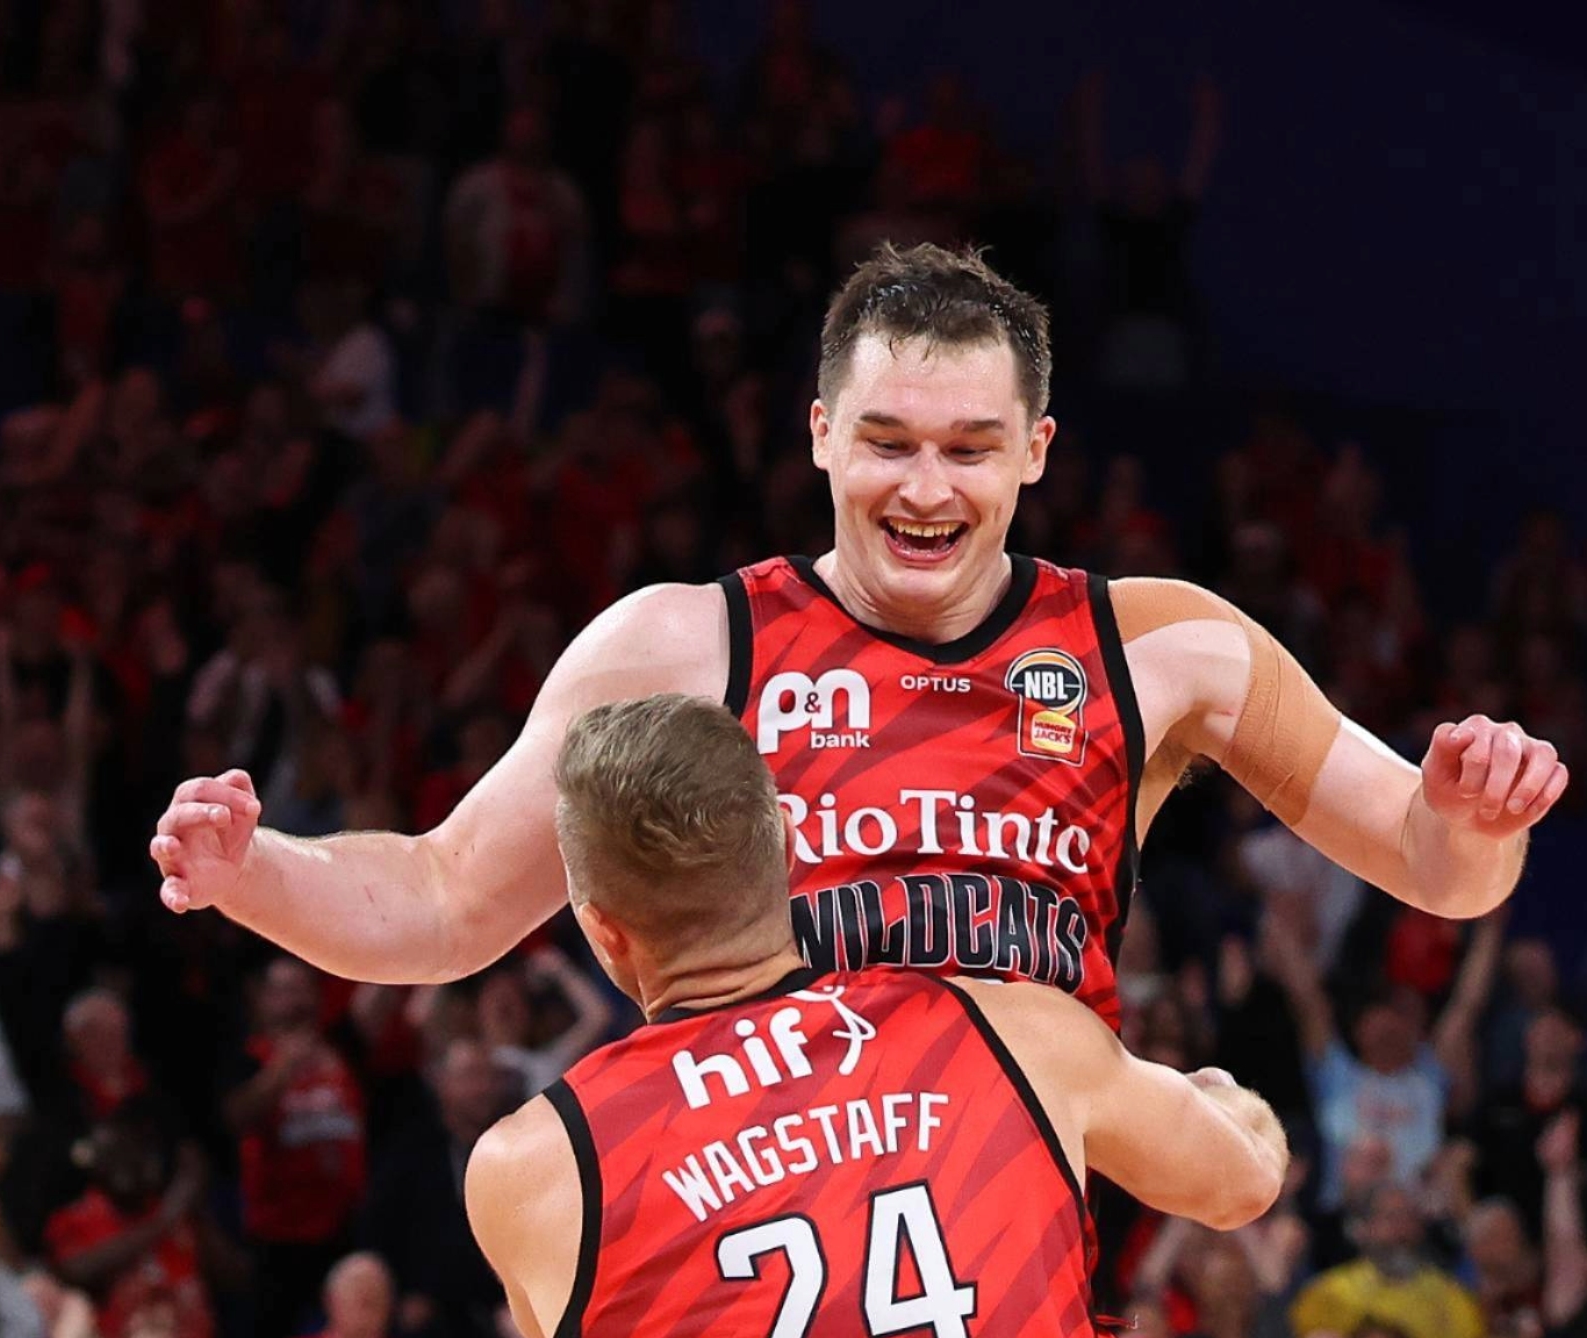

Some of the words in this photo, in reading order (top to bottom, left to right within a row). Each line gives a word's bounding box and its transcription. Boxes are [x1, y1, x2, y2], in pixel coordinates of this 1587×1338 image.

[900, 674, 971, 693] OPTUS
[1024, 671, 1069, 700] NBL
[810, 730, 870, 749] bank
[775, 792, 898, 864] Rio
[900, 788, 1091, 875] Tinto
[789, 871, 1089, 996] WILDCATS
[671, 1006, 813, 1110] hif
[662, 1091, 949, 1222] WAGSTAFF
